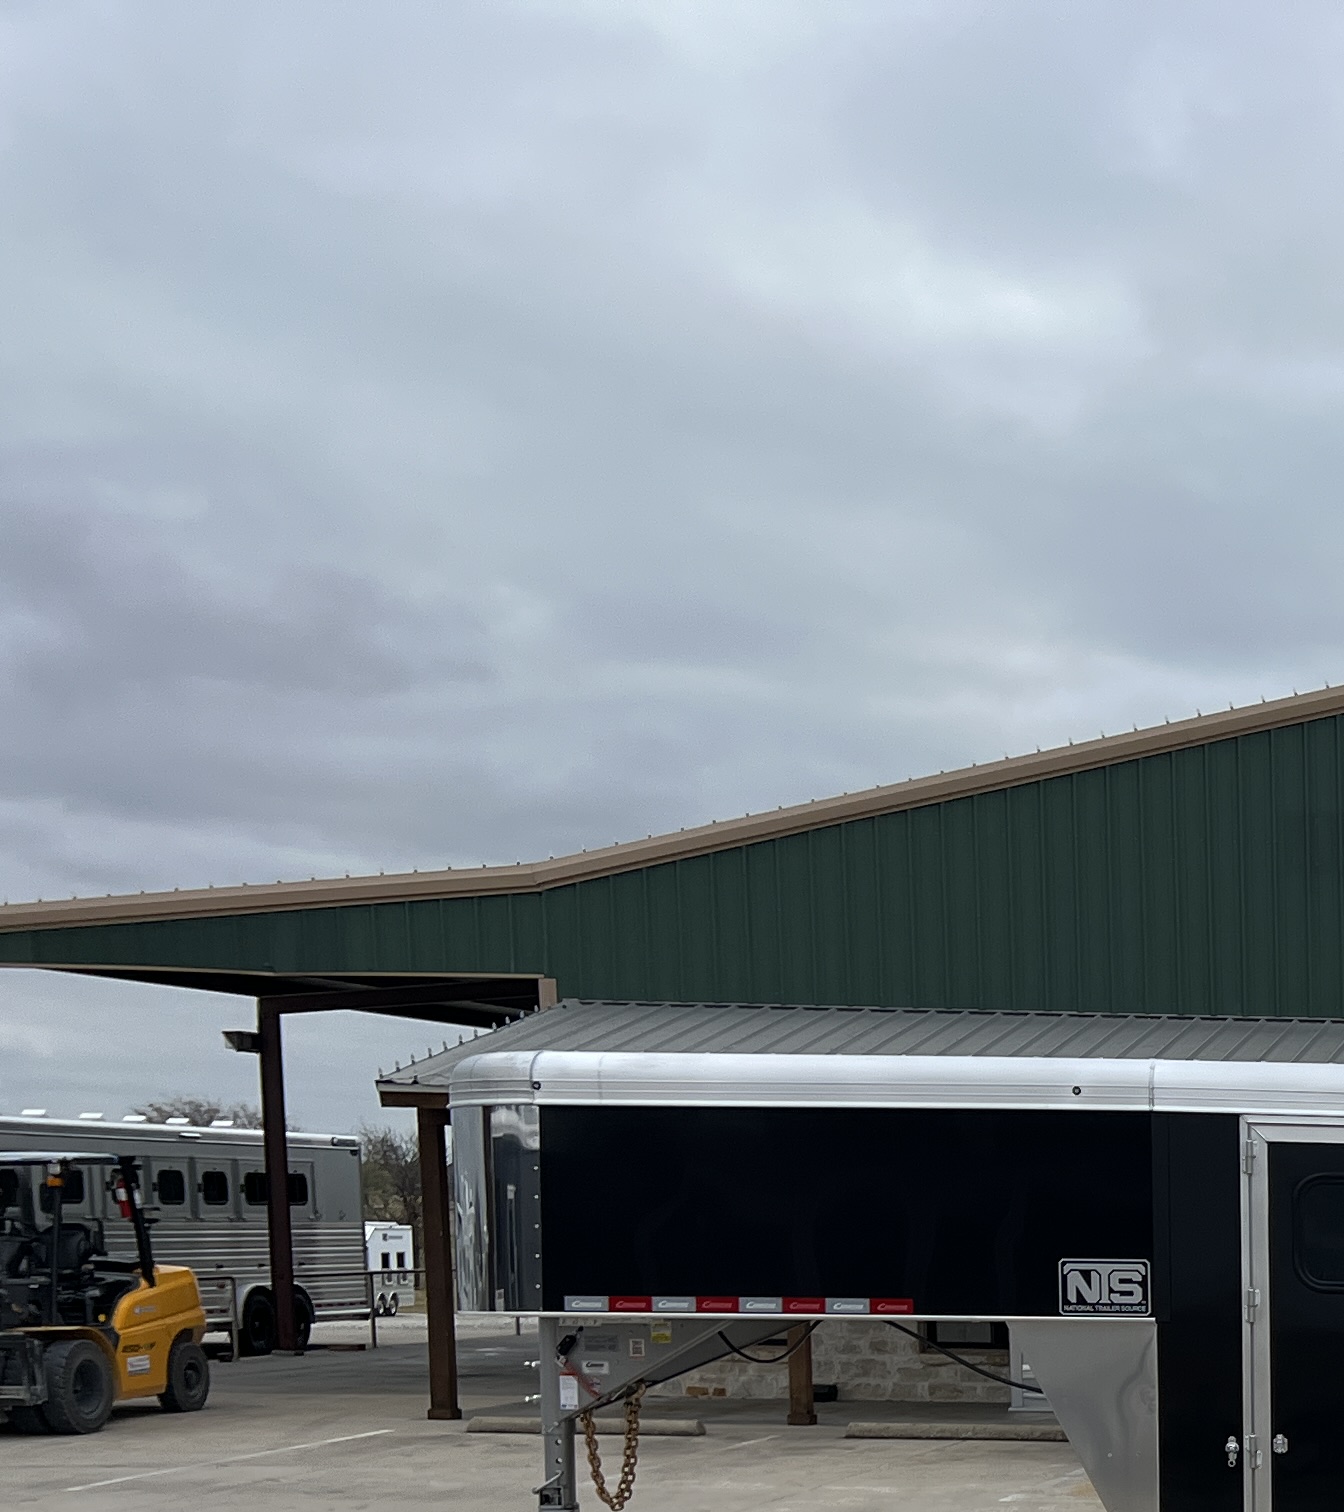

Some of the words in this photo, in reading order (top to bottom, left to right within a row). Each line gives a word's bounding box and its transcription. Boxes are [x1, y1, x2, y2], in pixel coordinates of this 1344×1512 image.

[1063, 1263, 1146, 1304] NTS
[1063, 1304, 1094, 1312] NATIONAL
[1095, 1304, 1120, 1312] TRAILER
[1121, 1304, 1146, 1312] SOURCE
